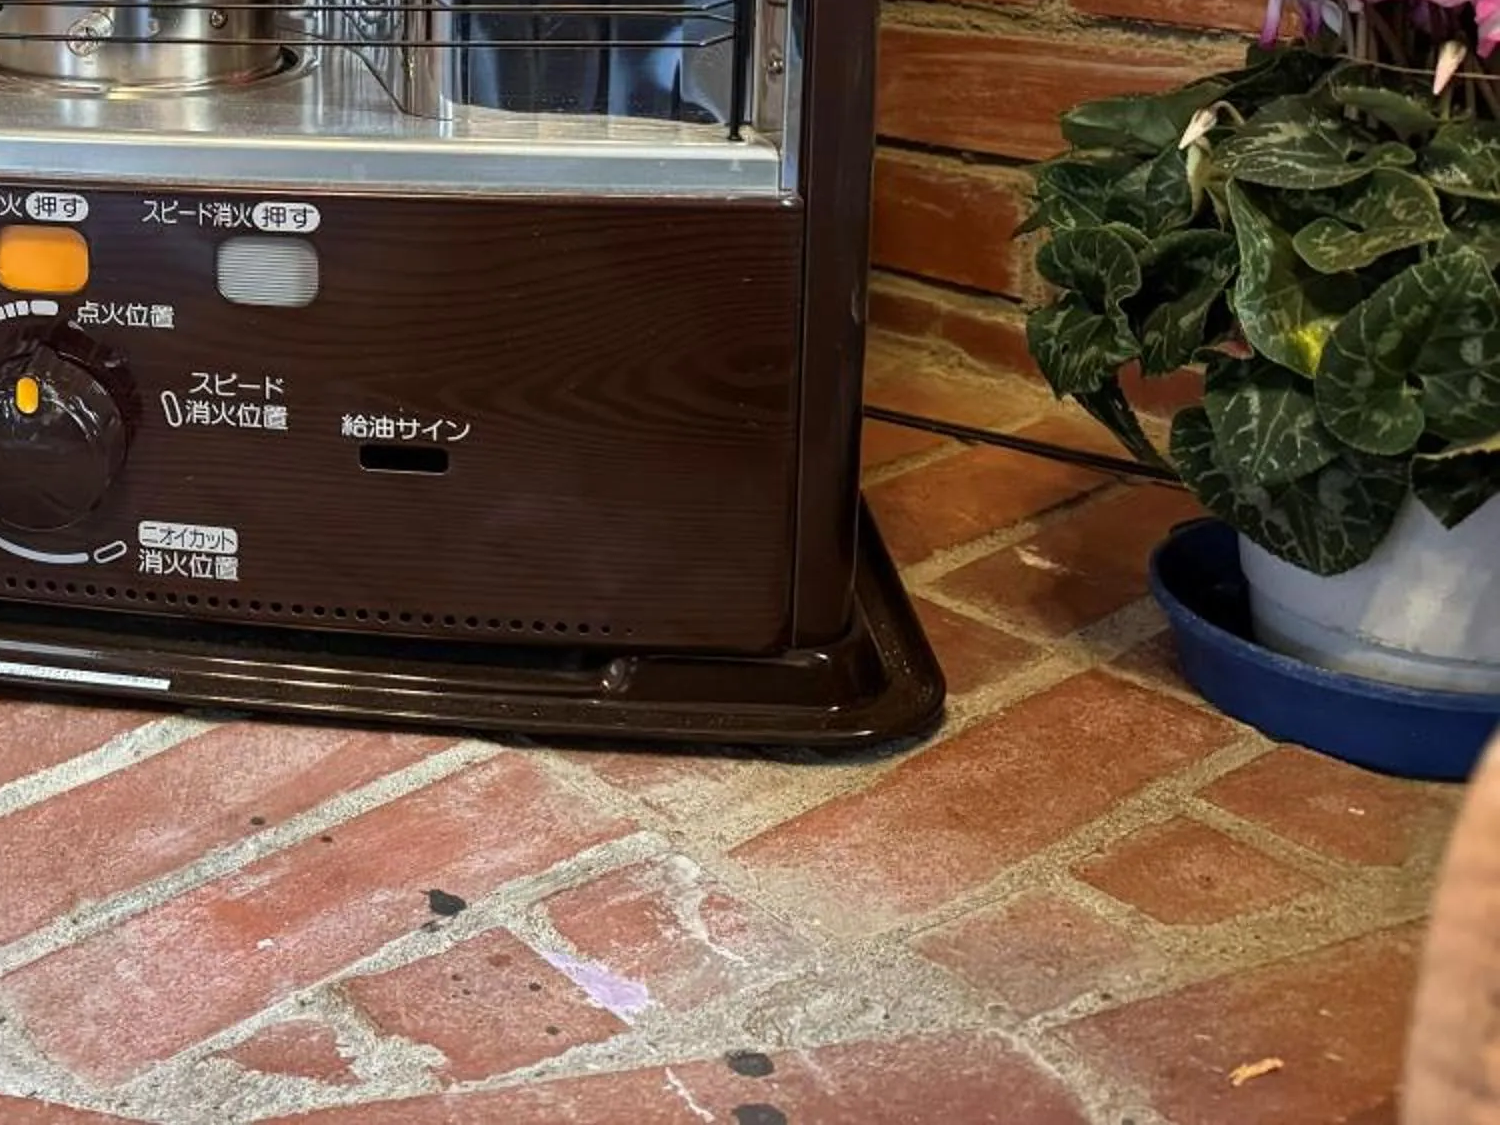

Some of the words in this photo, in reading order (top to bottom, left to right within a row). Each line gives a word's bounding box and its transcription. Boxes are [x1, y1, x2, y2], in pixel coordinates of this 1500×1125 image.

[34, 194, 84, 217] 押す
[142, 200, 251, 228] スピード消火
[260, 205, 314, 228] 押す
[76, 303, 174, 329] 点火位置
[190, 372, 285, 398] スピード
[185, 400, 288, 430] 消火位置
[341, 414, 470, 442] 給油サイン
[141, 525, 235, 549] ニオイカット
[138, 549, 239, 581] 消火位置
